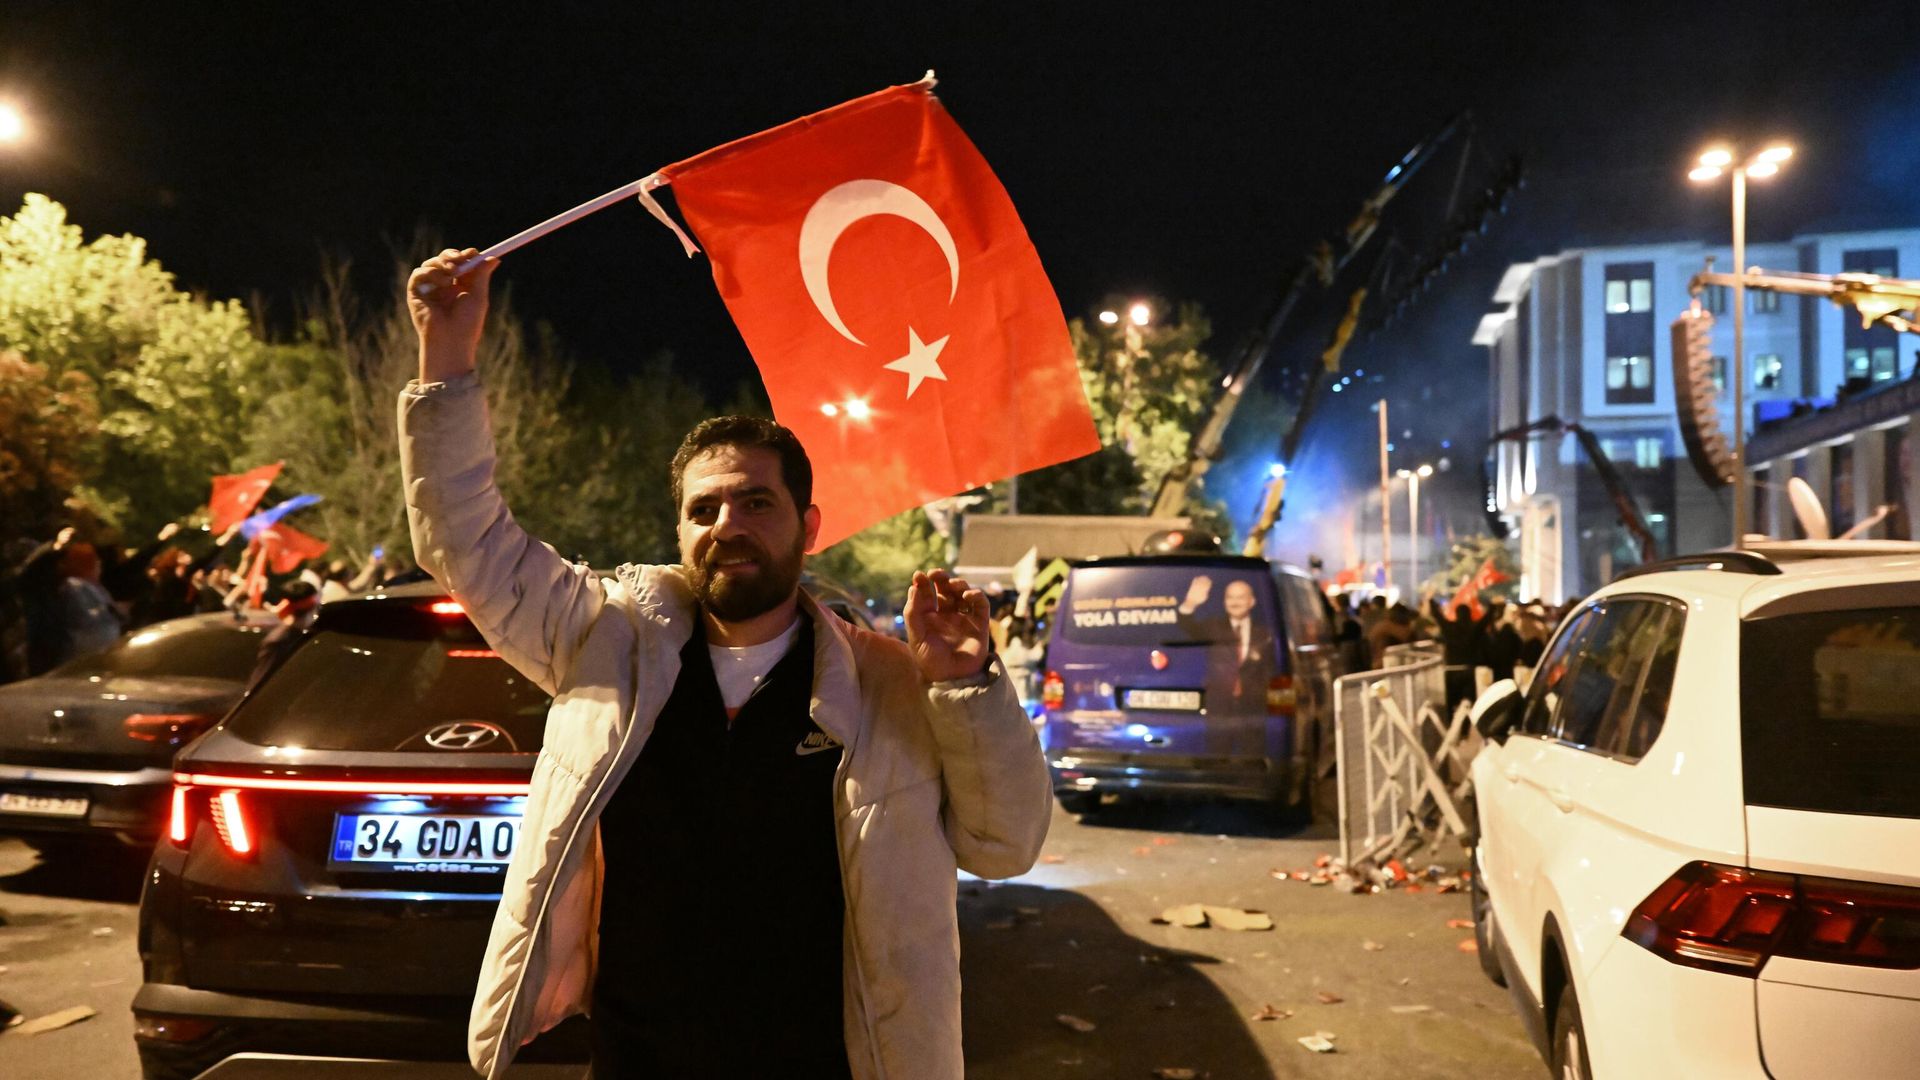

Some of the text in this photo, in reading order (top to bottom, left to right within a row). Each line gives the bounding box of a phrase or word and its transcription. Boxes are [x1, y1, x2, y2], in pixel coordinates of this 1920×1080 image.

[1073, 608, 1177, 629] YOLA DEVAM
[338, 840, 353, 851] TR
[358, 820, 402, 858] 34
